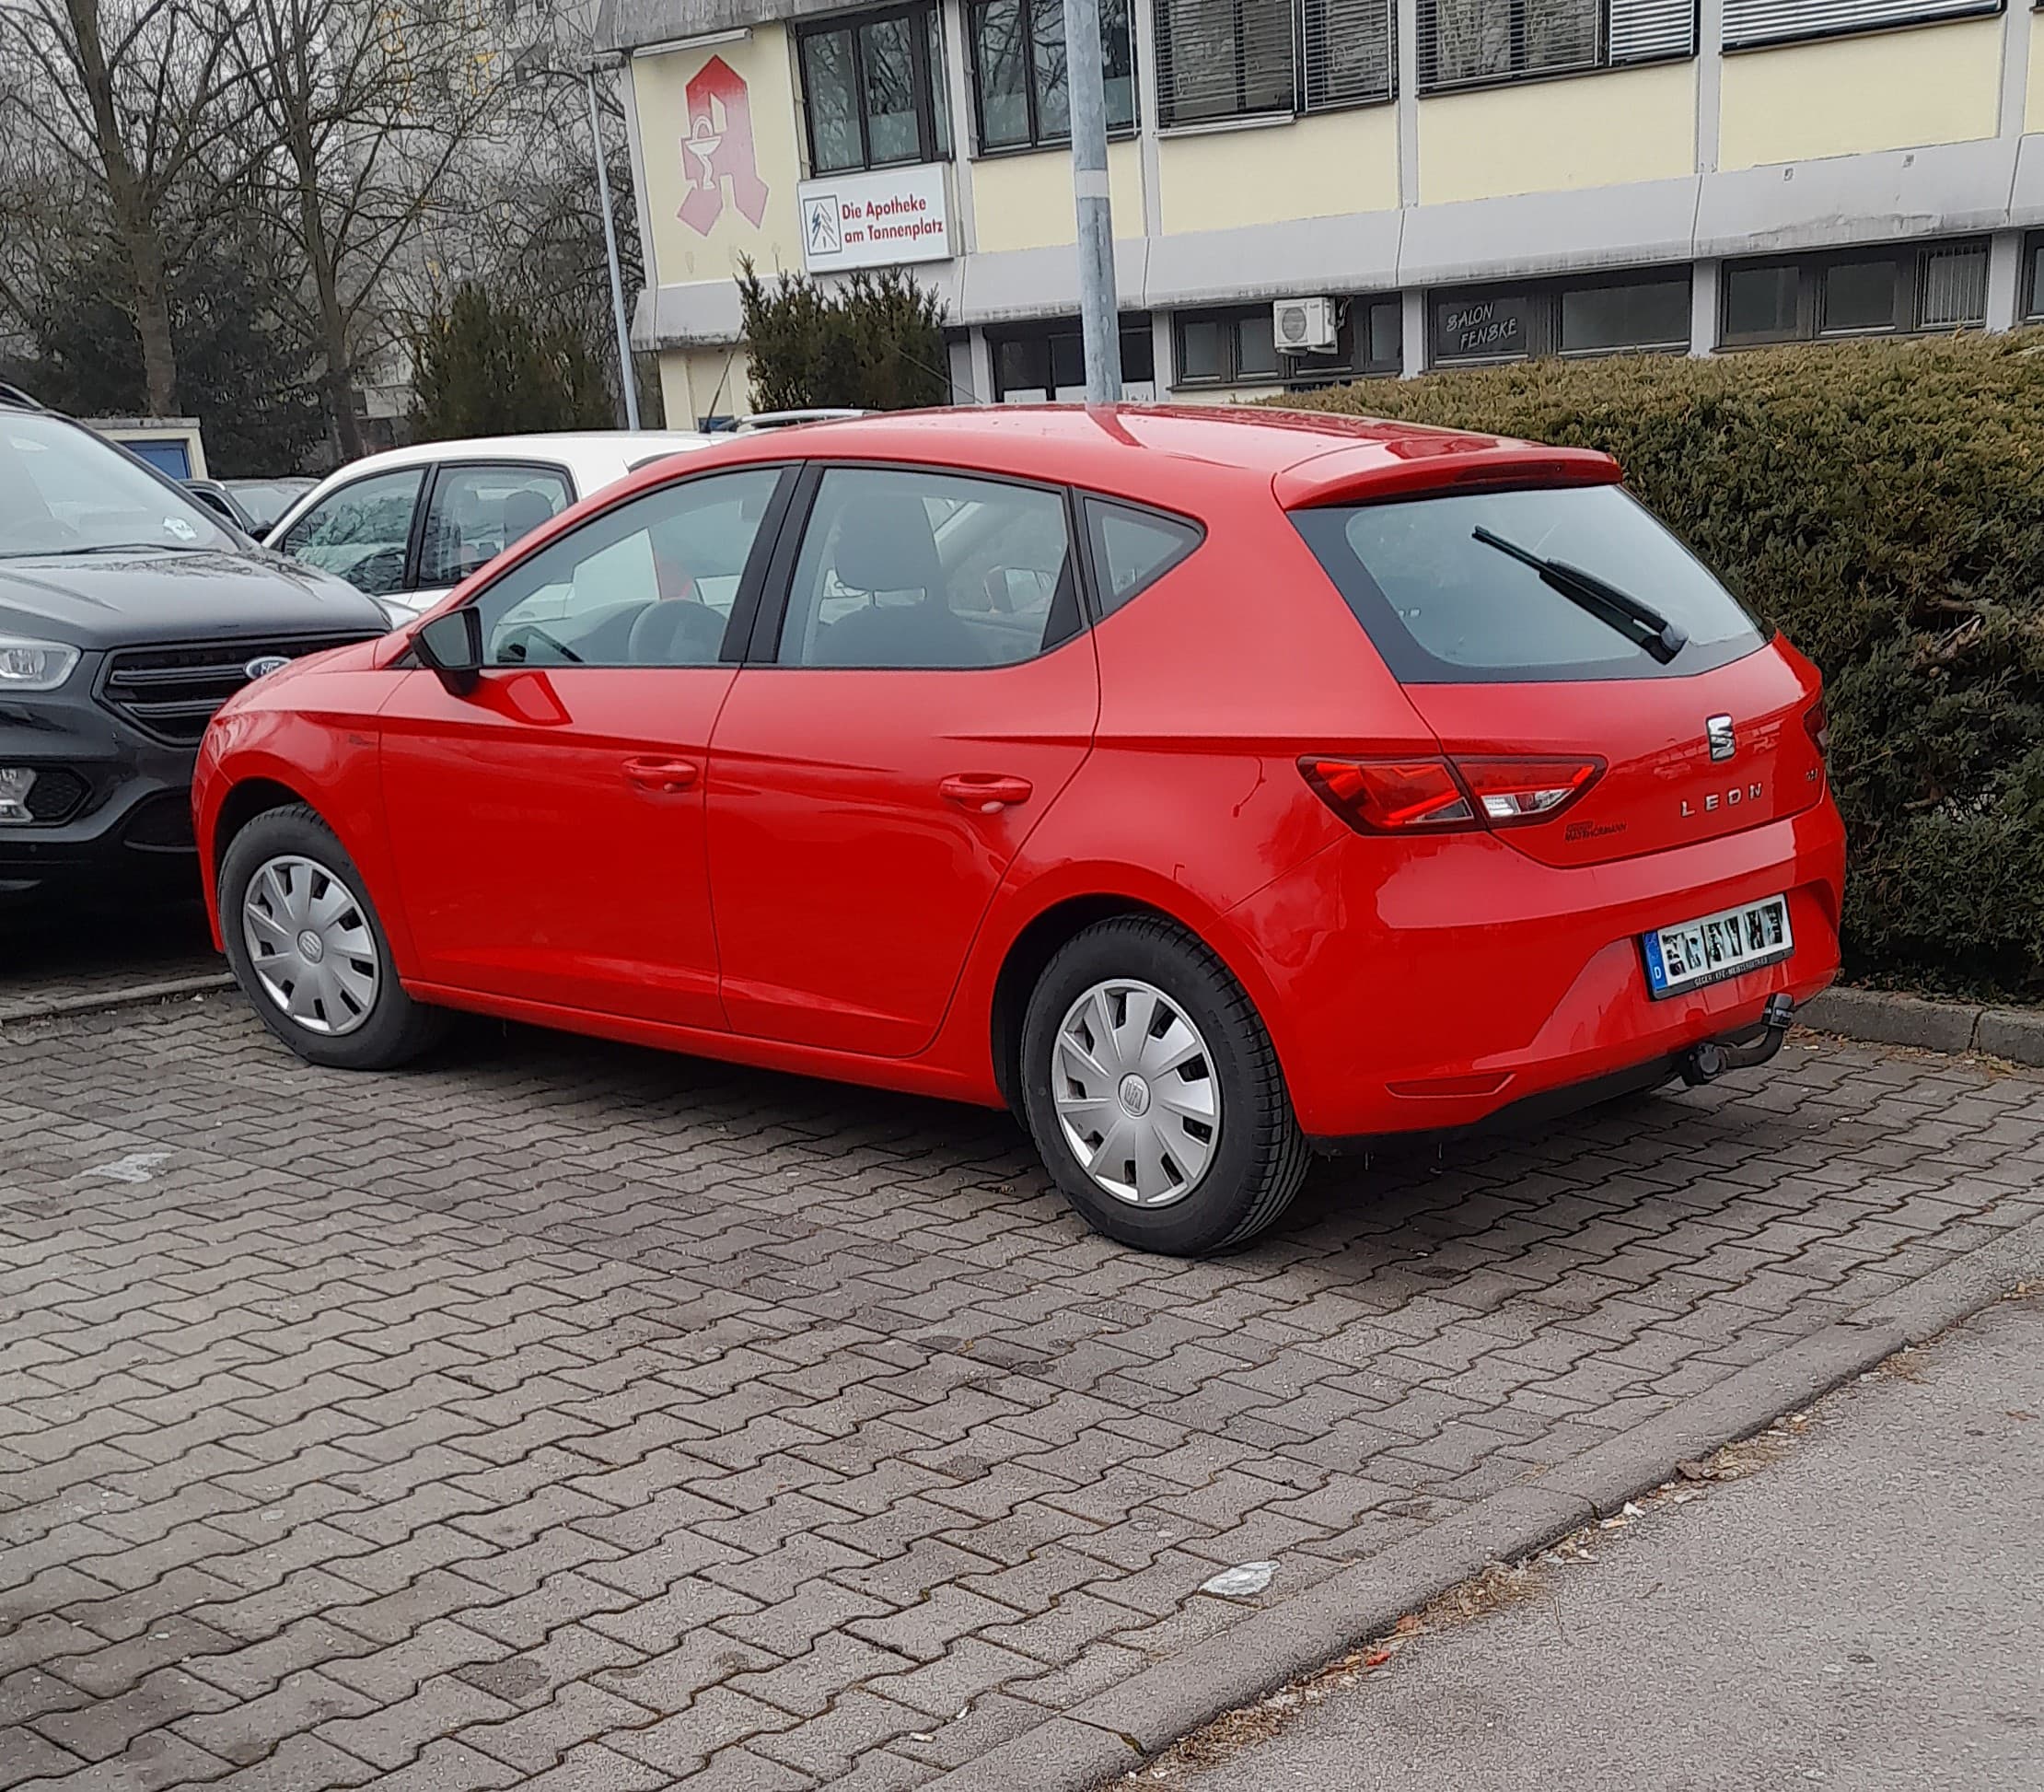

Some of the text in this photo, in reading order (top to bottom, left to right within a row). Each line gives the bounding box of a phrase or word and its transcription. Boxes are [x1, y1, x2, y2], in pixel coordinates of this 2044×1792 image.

[842, 193, 927, 221] Die Apotheke
[844, 217, 945, 244] am Tannenplatz
[1446, 302, 1494, 332] SALON
[1460, 318, 1517, 351] FENSKE
[1681, 783, 1762, 818] LEON
[1654, 966, 1662, 980] D
